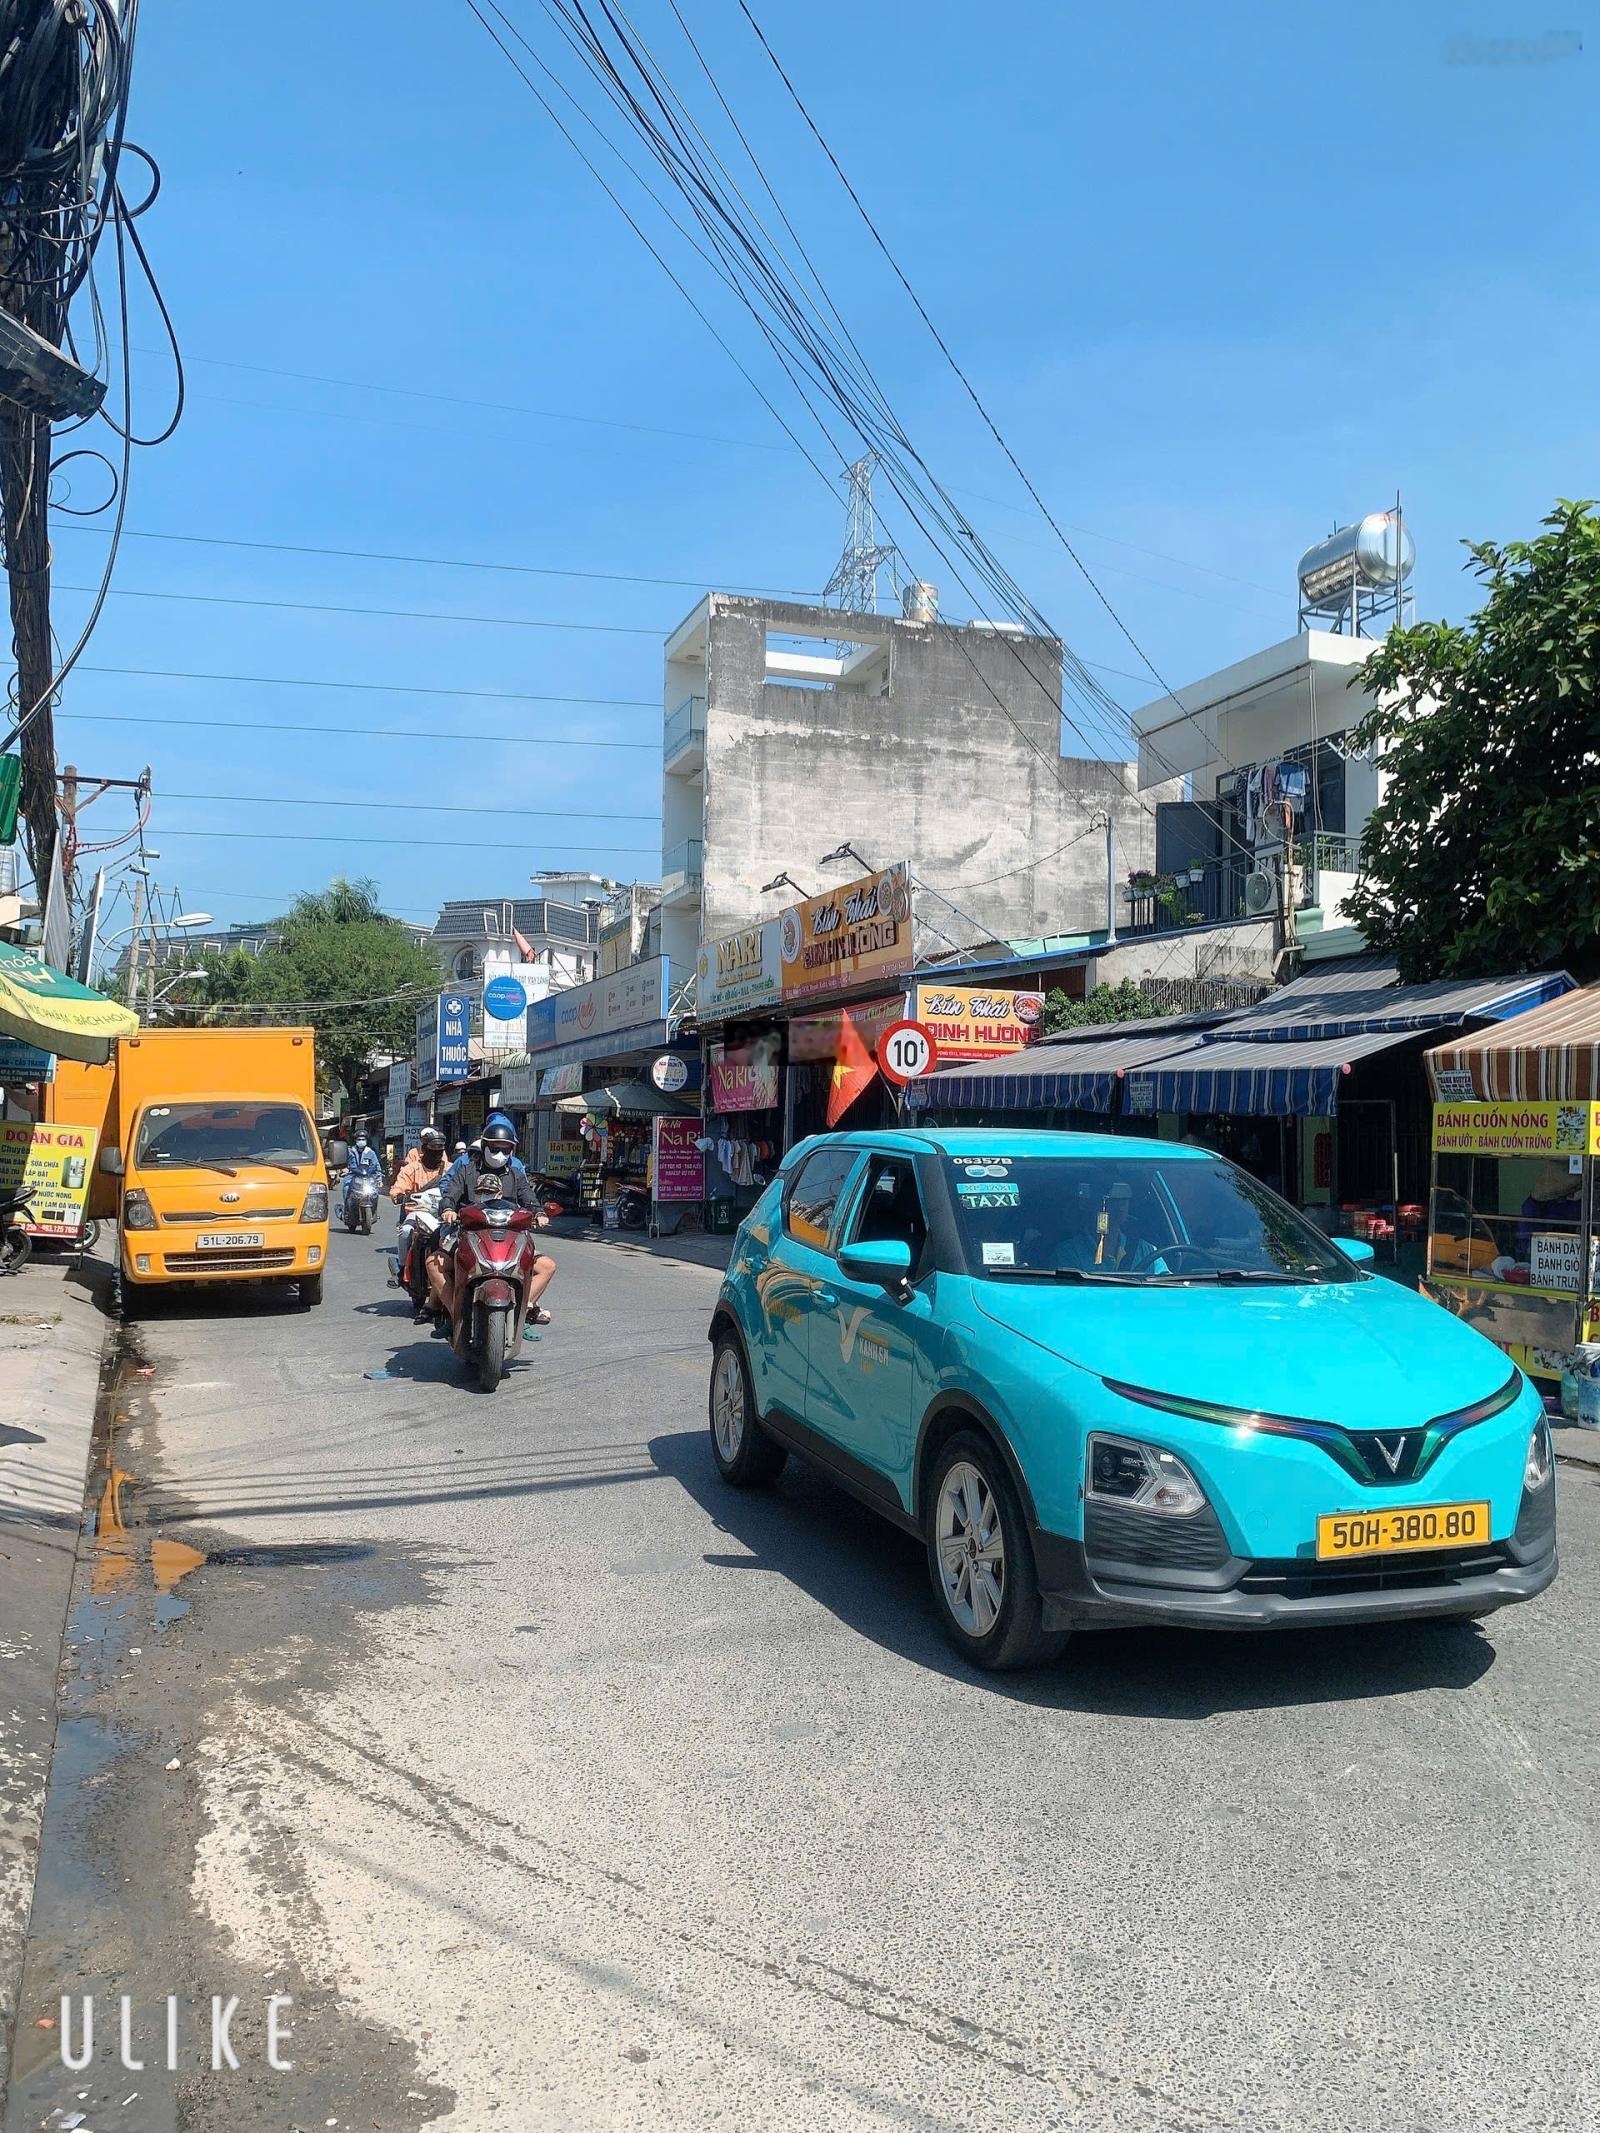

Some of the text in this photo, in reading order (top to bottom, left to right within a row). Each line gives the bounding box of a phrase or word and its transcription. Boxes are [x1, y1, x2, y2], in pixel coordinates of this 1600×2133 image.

[811, 902, 842, 935] Bún
[716, 929, 763, 976] NARI
[924, 994, 1010, 1018] Bún Thái
[445, 1018, 463, 1036] NHÀ
[441, 1042, 467, 1062] THUỐC
[1437, 1107, 1548, 1128] BÁNH CUỐN NÓNG
[57, 1133, 84, 1147] GIA
[662, 1131, 683, 1146] Na
[1436, 1133, 1457, 1147] BÁNH
[1478, 1134, 1499, 1148] BÁNH
[1501, 1132, 1523, 1149] CUỐN
[1525, 1133, 1552, 1149] TRỨNG
[222, 1193, 239, 1202] KIA
[967, 1193, 1018, 1208] TAXI
[203, 1235, 259, 1246] 51L-206.79
[1537, 1239, 1561, 1255] BÁNH
[1538, 1256, 1562, 1271] BÁNH
[1531, 1271, 1580, 1289] BÁNH TRƯN
[1333, 1510, 1476, 1549] 50H-380.80
